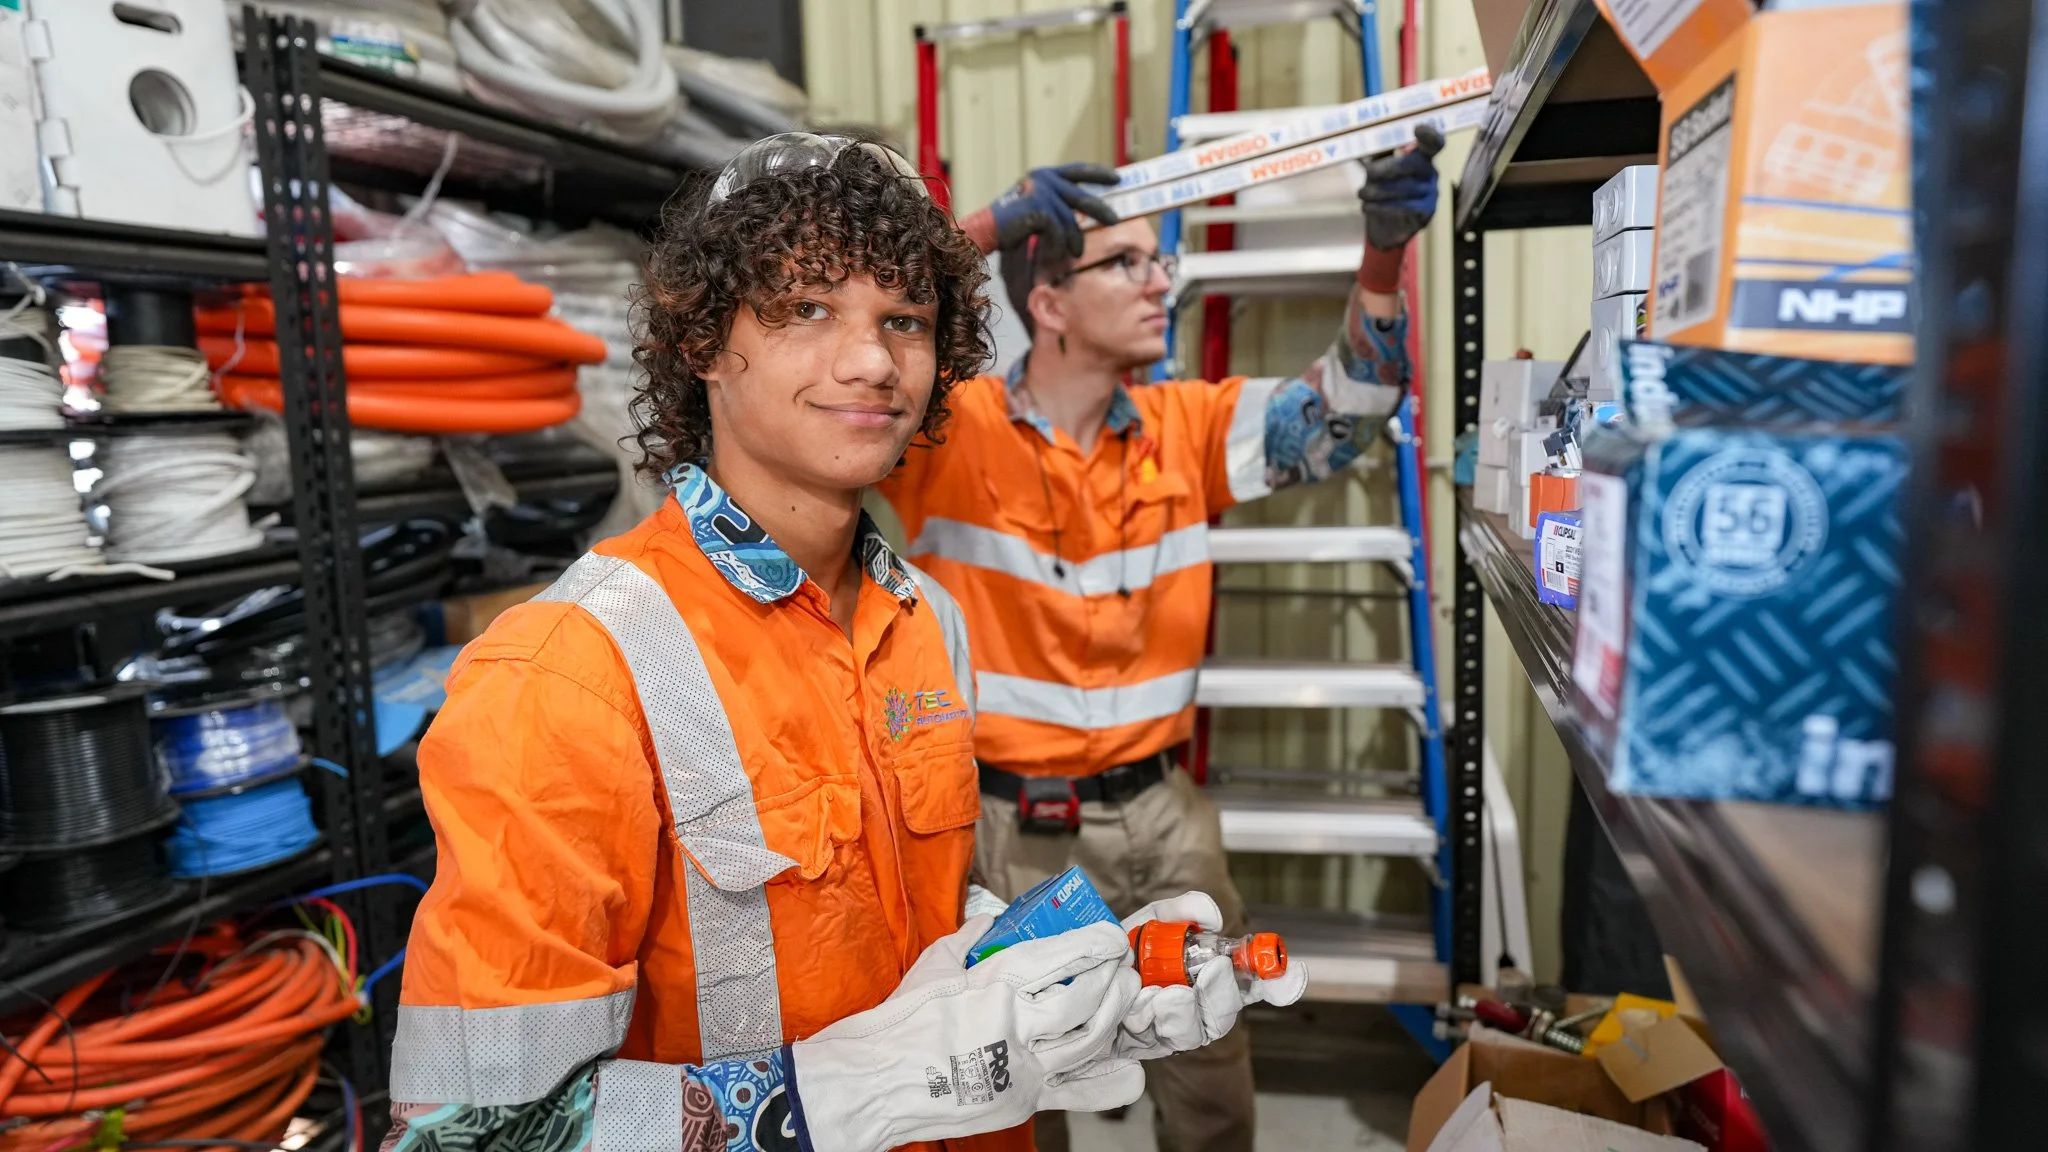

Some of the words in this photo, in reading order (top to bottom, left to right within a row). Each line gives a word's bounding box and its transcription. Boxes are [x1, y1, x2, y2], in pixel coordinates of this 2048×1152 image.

[1197, 135, 1267, 166] OSRAM
[1252, 148, 1323, 180] OSRAM
[1778, 287, 1908, 325] NHP
[1717, 496, 1774, 536] 56
[1557, 525, 1577, 541] CLIPSAL
[916, 690, 952, 711] TEC
[1057, 873, 1084, 903] CLIPSAL
[984, 1039, 1010, 1093] PRO
